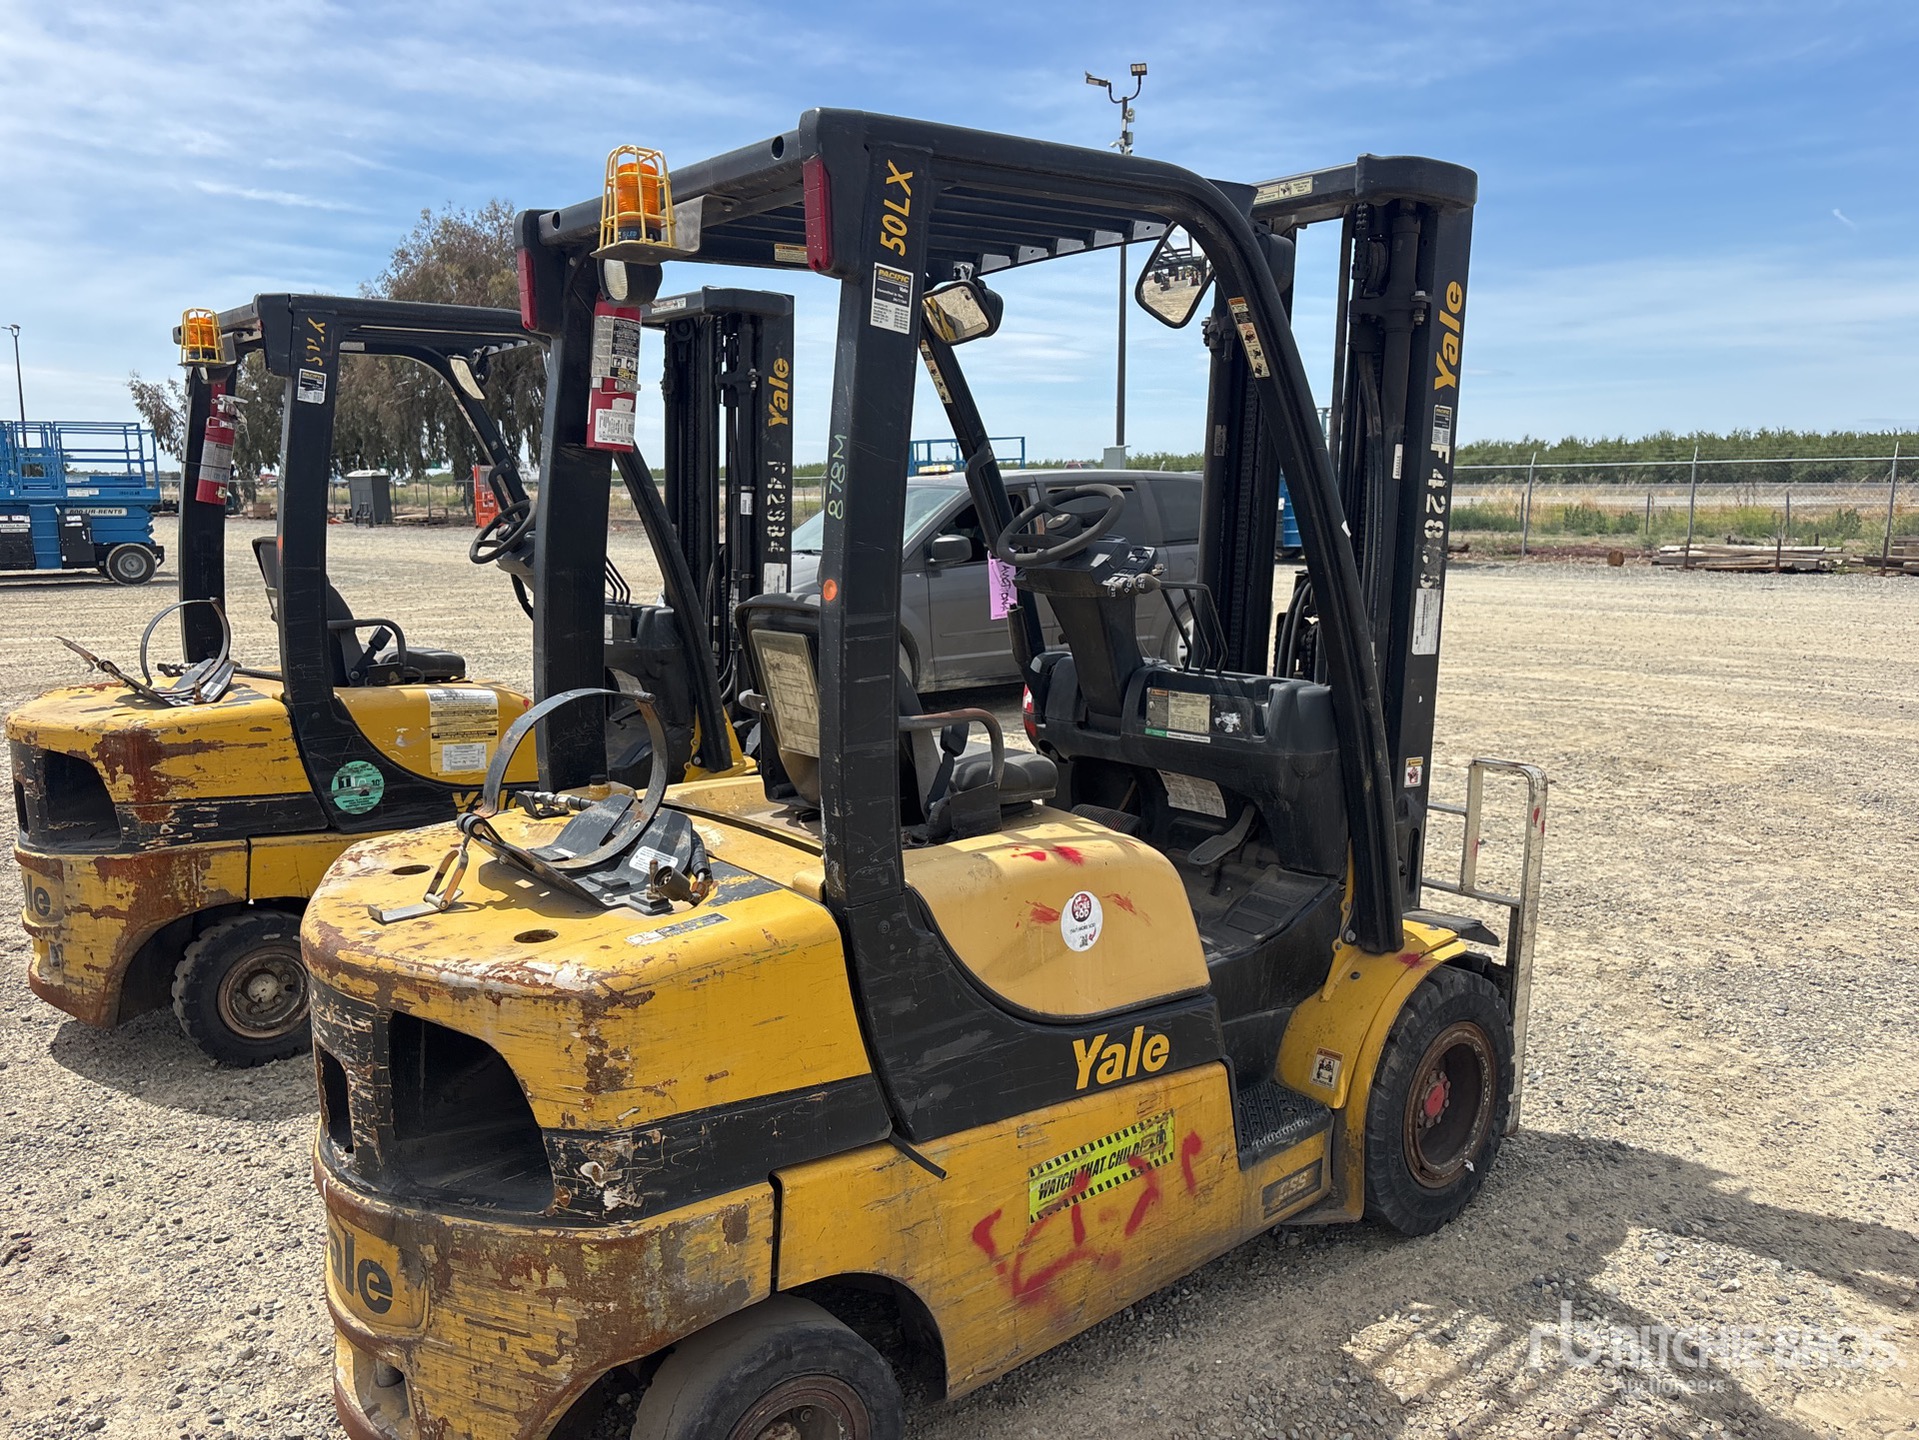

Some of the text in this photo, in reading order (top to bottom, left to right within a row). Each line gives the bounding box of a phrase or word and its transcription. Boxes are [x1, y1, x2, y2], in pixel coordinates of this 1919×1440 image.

[880, 159, 914, 257] 50LX
[877, 269, 910, 283] PACIFIC
[1434, 281, 1463, 390] Yale
[768, 357, 790, 427] Yale
[827, 434, 847, 520] 878M
[1072, 1026, 1170, 1091] Yale
[1038, 1168, 1078, 1200] WATCH
[1080, 1155, 1107, 1178] THAT
